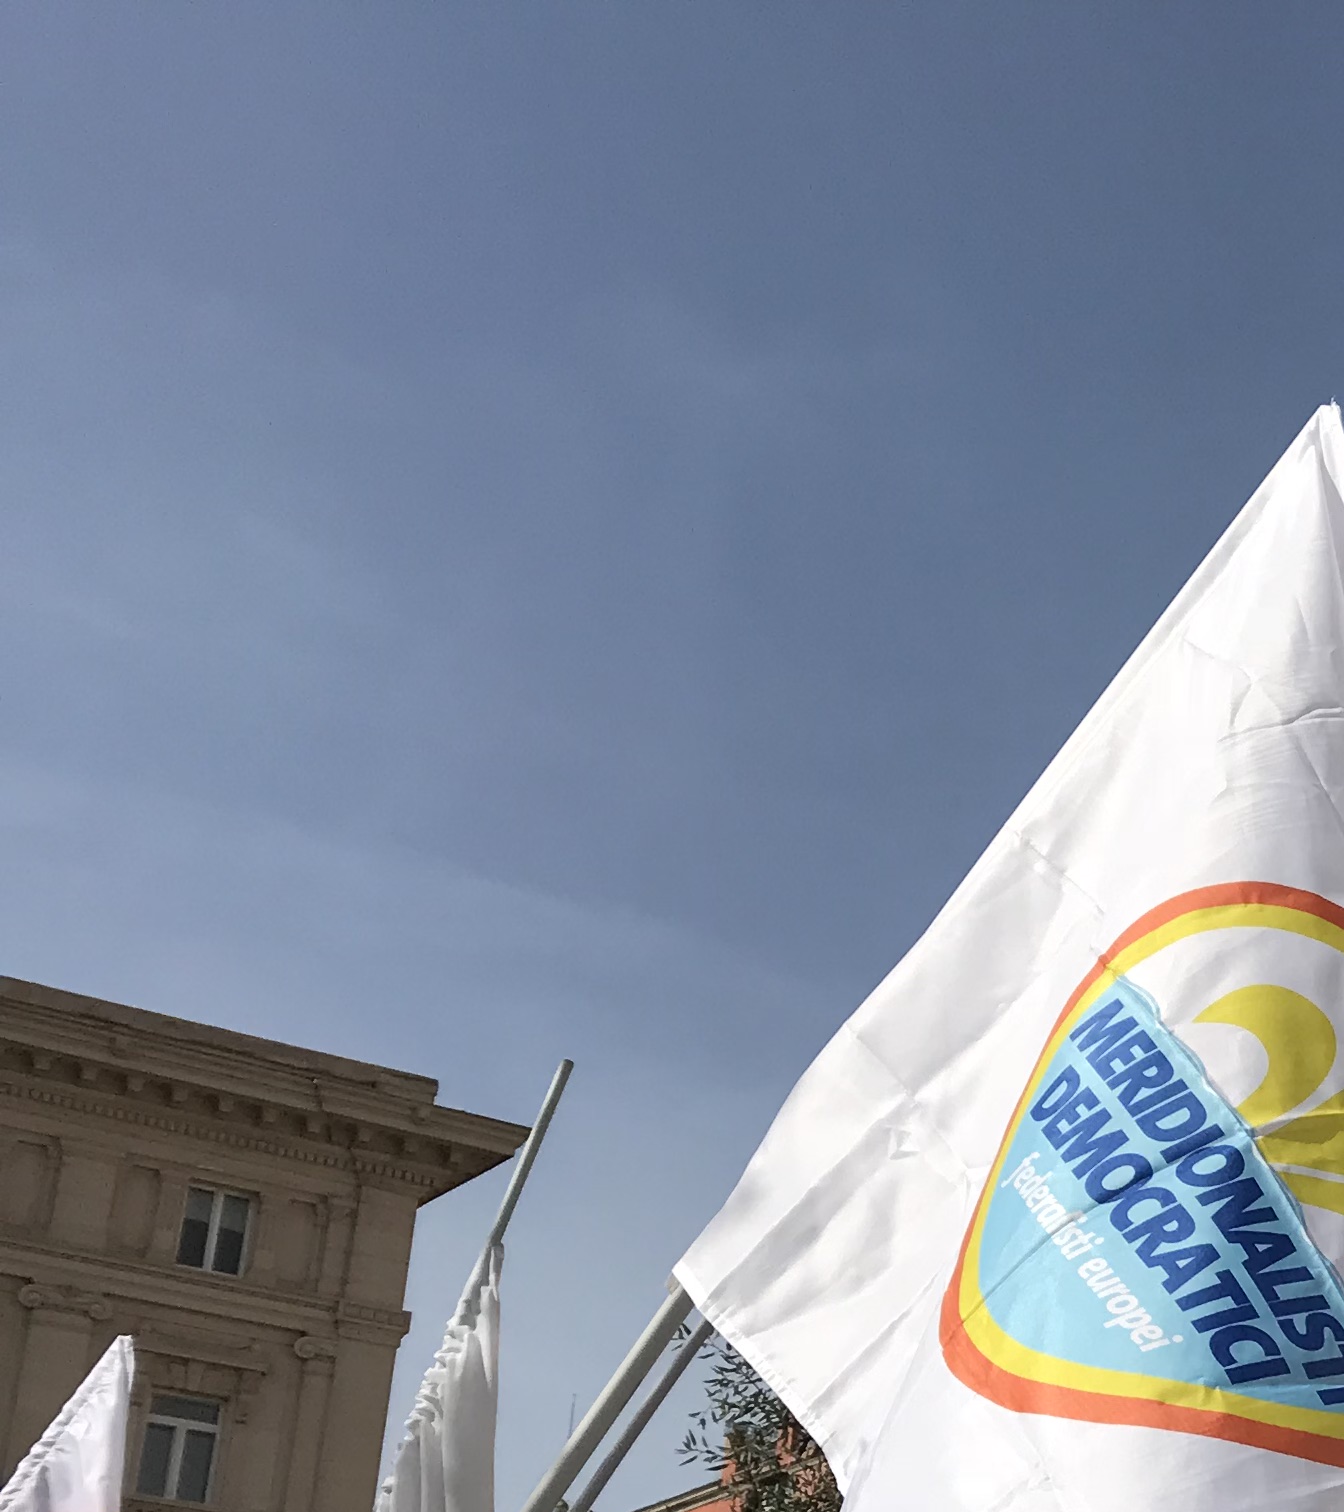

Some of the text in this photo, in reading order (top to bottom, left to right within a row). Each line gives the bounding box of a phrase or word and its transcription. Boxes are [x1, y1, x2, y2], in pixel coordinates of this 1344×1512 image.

[1000, 1150, 1090, 1264] federalisti
[1029, 1064, 1293, 1387] DEMOCRATICI
[1077, 1241, 1186, 1354] europei
